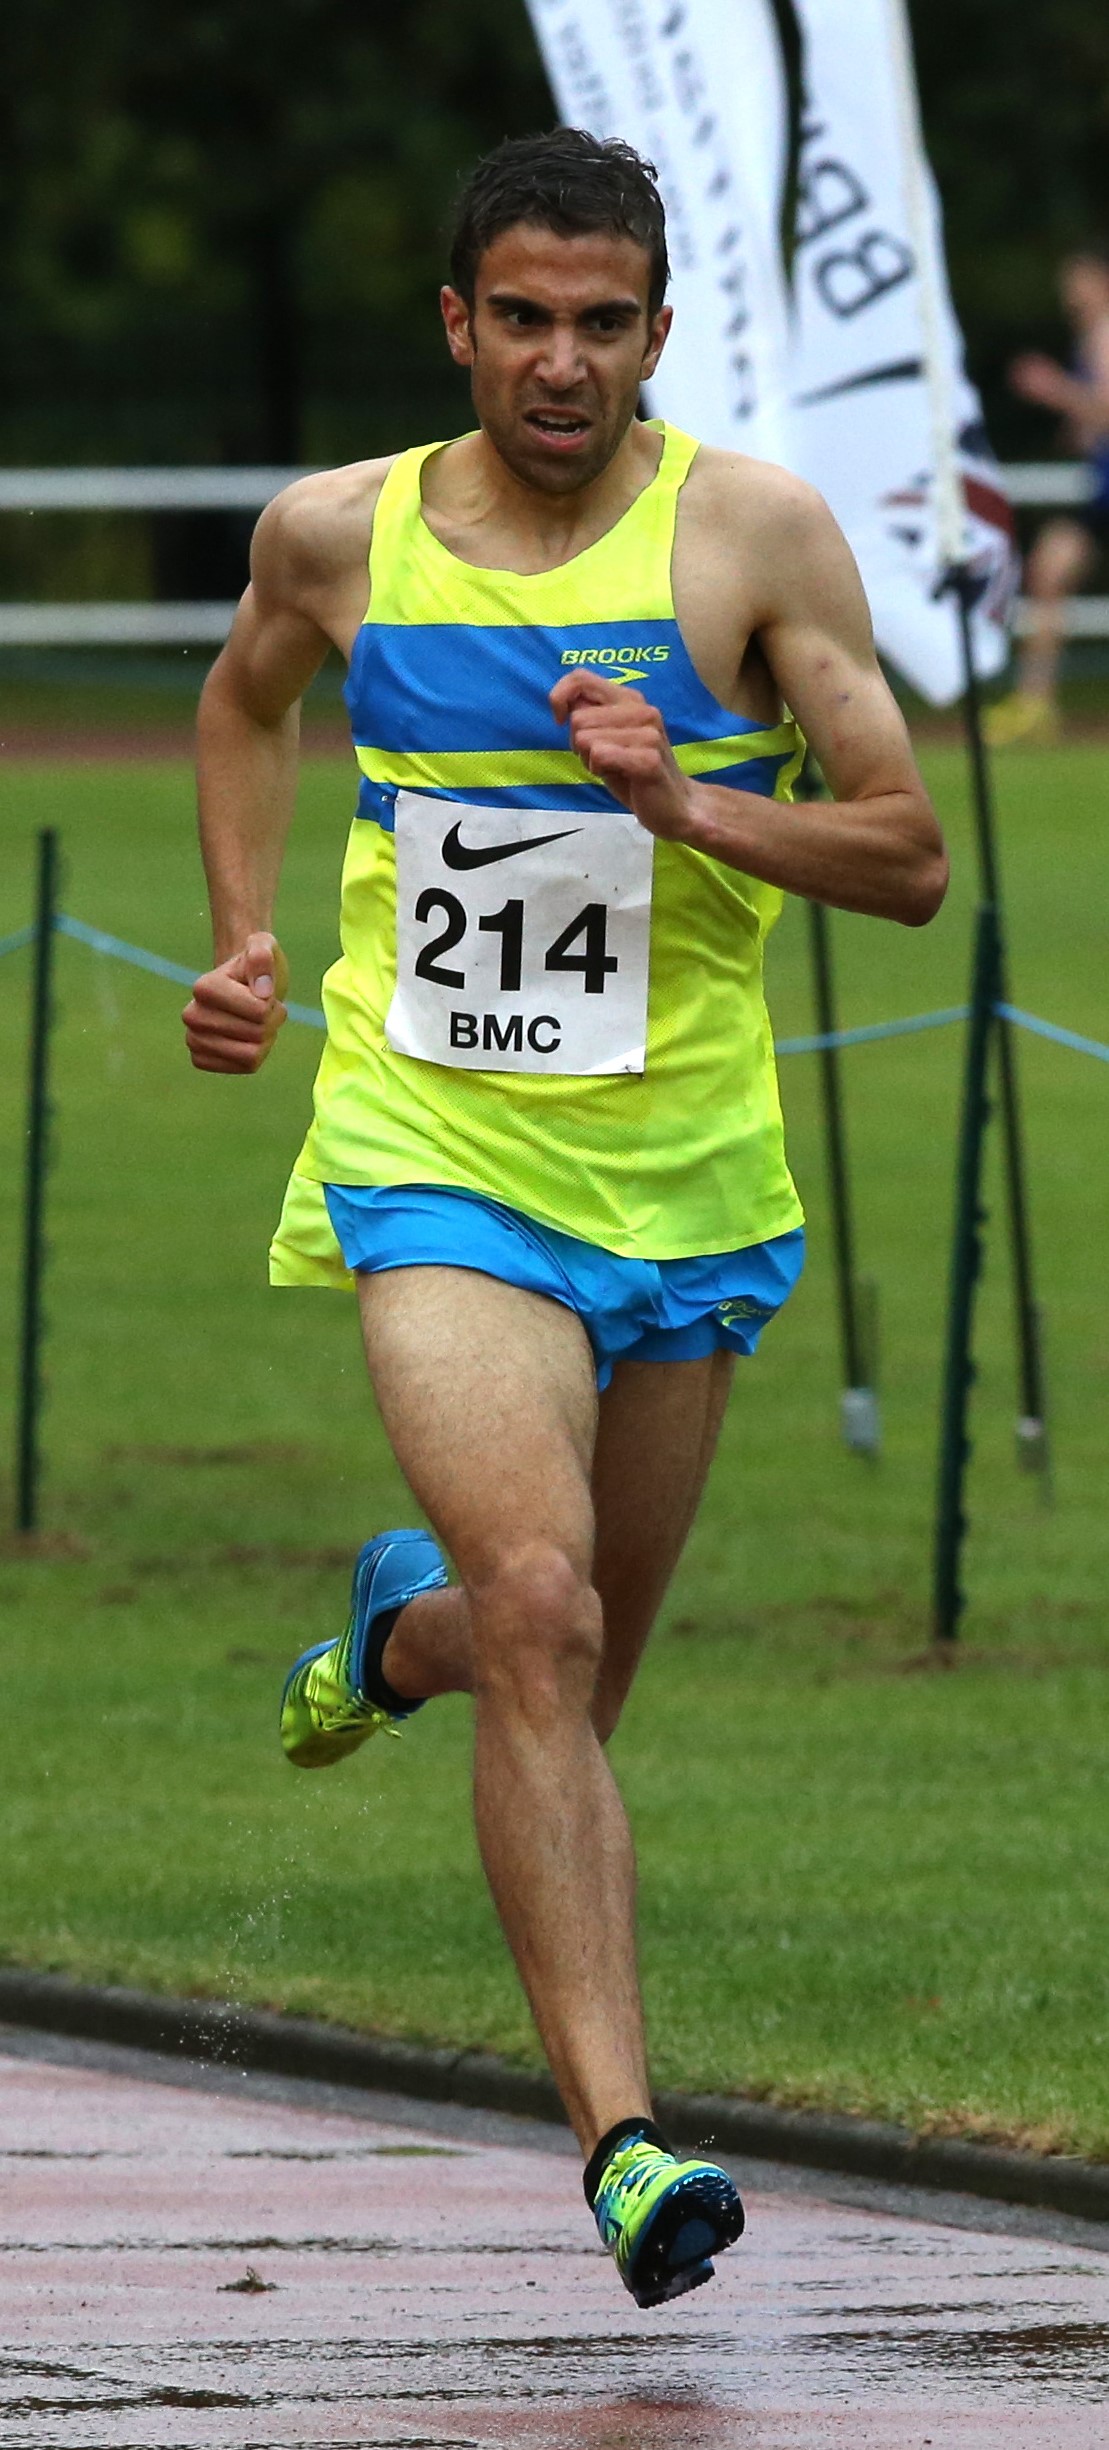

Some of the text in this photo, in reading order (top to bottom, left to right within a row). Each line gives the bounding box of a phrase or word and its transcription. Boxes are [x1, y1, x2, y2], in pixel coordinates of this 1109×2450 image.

[560, 645, 671, 665] BROOKS
[414, 887, 618, 994] 214
[450, 1011, 561, 1054] BMC
